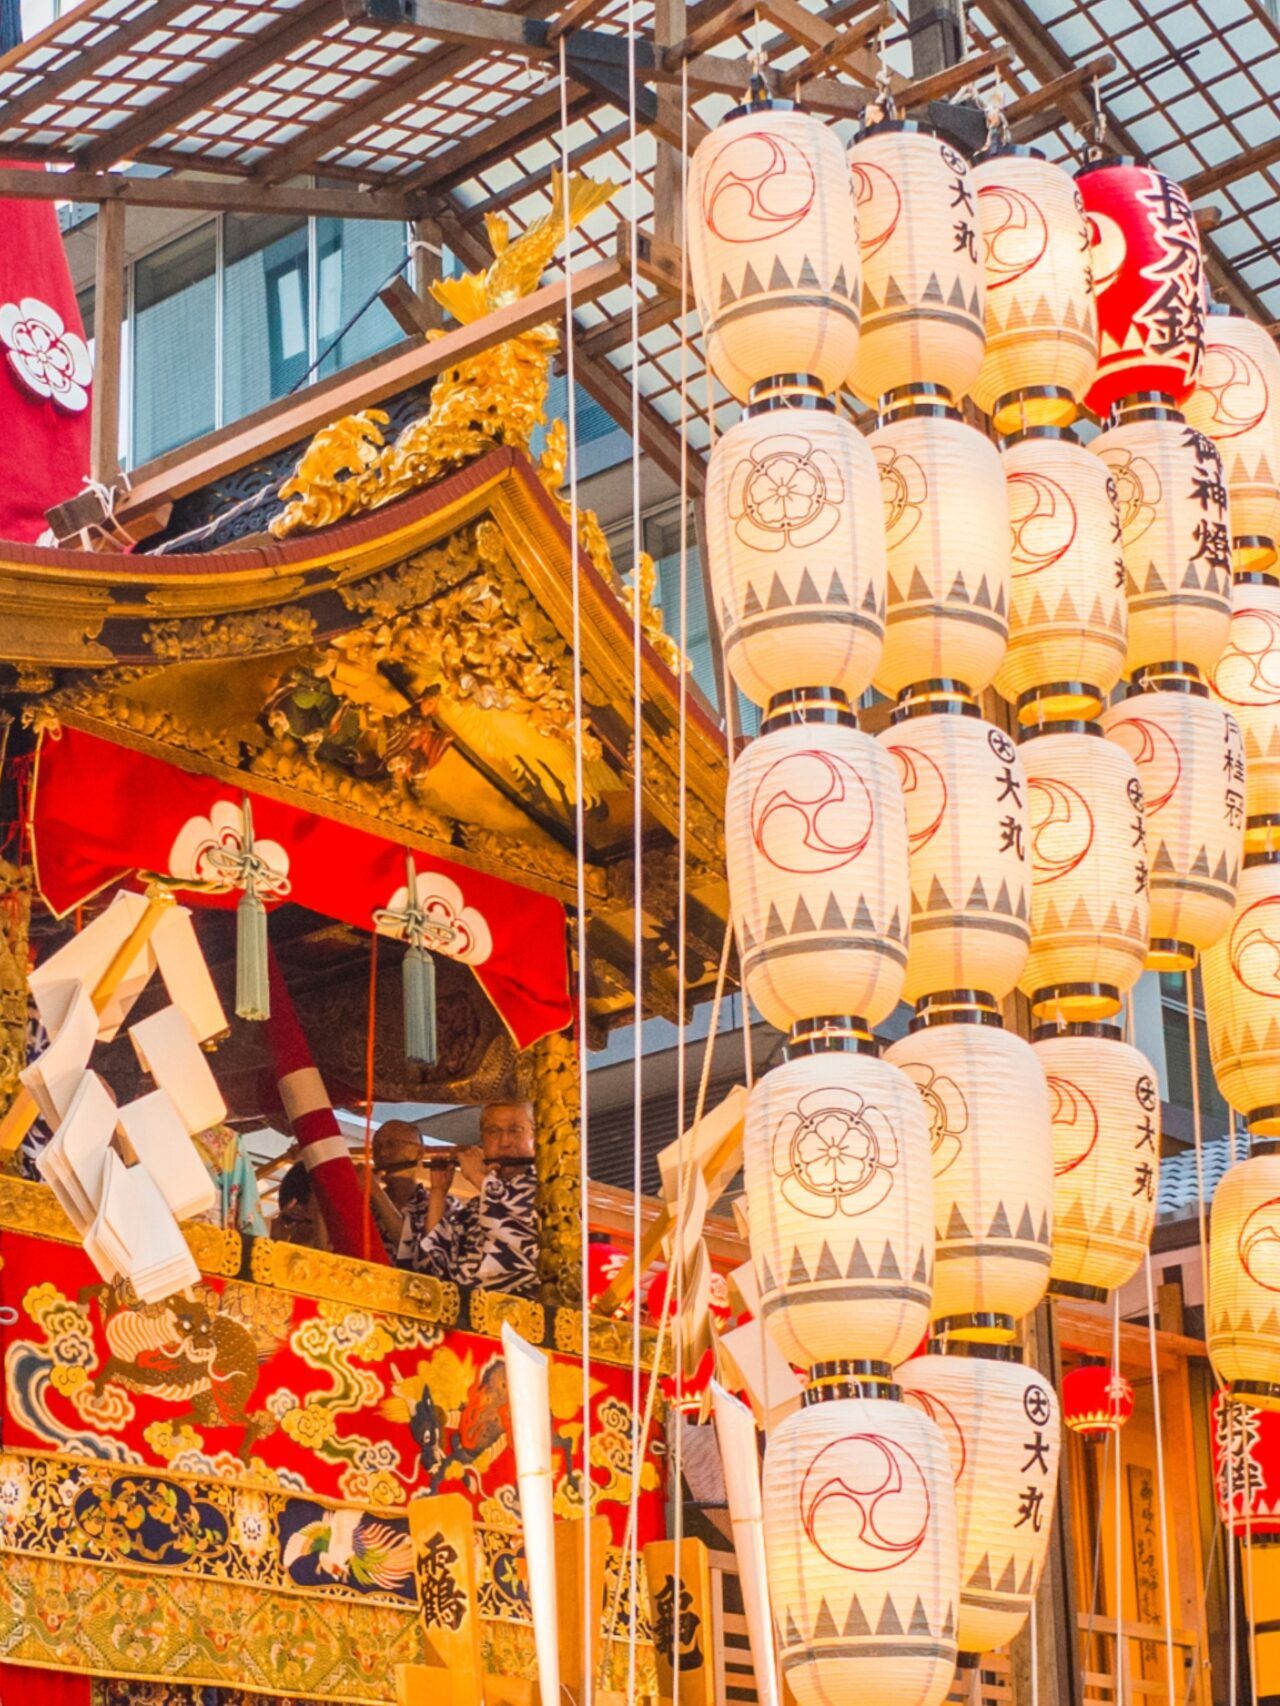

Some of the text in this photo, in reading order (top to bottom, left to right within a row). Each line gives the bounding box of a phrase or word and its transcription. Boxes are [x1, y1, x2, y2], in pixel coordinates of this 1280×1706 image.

[948, 176, 978, 265] 大丸
[995, 766, 1026, 863] 大丸
[1131, 1114, 1155, 1203] 大丸
[1013, 1430, 1052, 1534] 大丸
